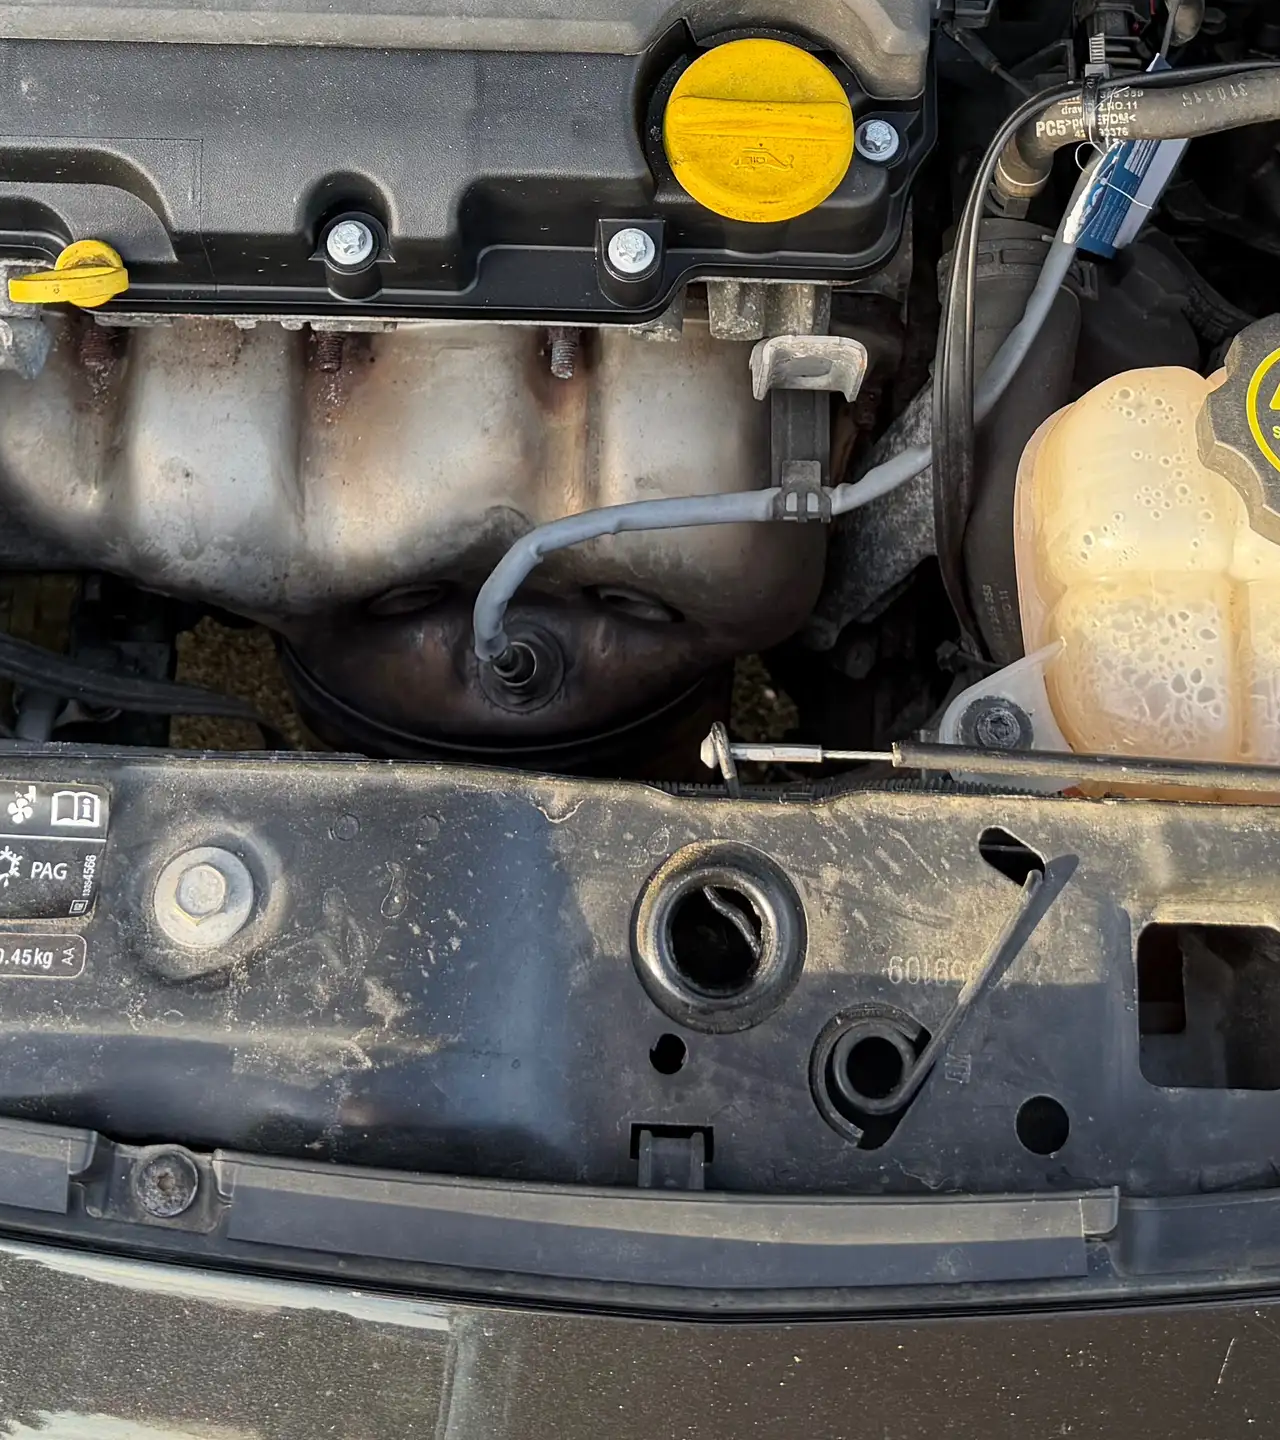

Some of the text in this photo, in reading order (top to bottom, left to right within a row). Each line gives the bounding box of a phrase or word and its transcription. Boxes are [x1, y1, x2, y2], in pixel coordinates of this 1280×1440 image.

[1035, 119, 1066, 138] PC5
[31, 862, 68, 880] PAG
[62, 947, 74, 966] AA
